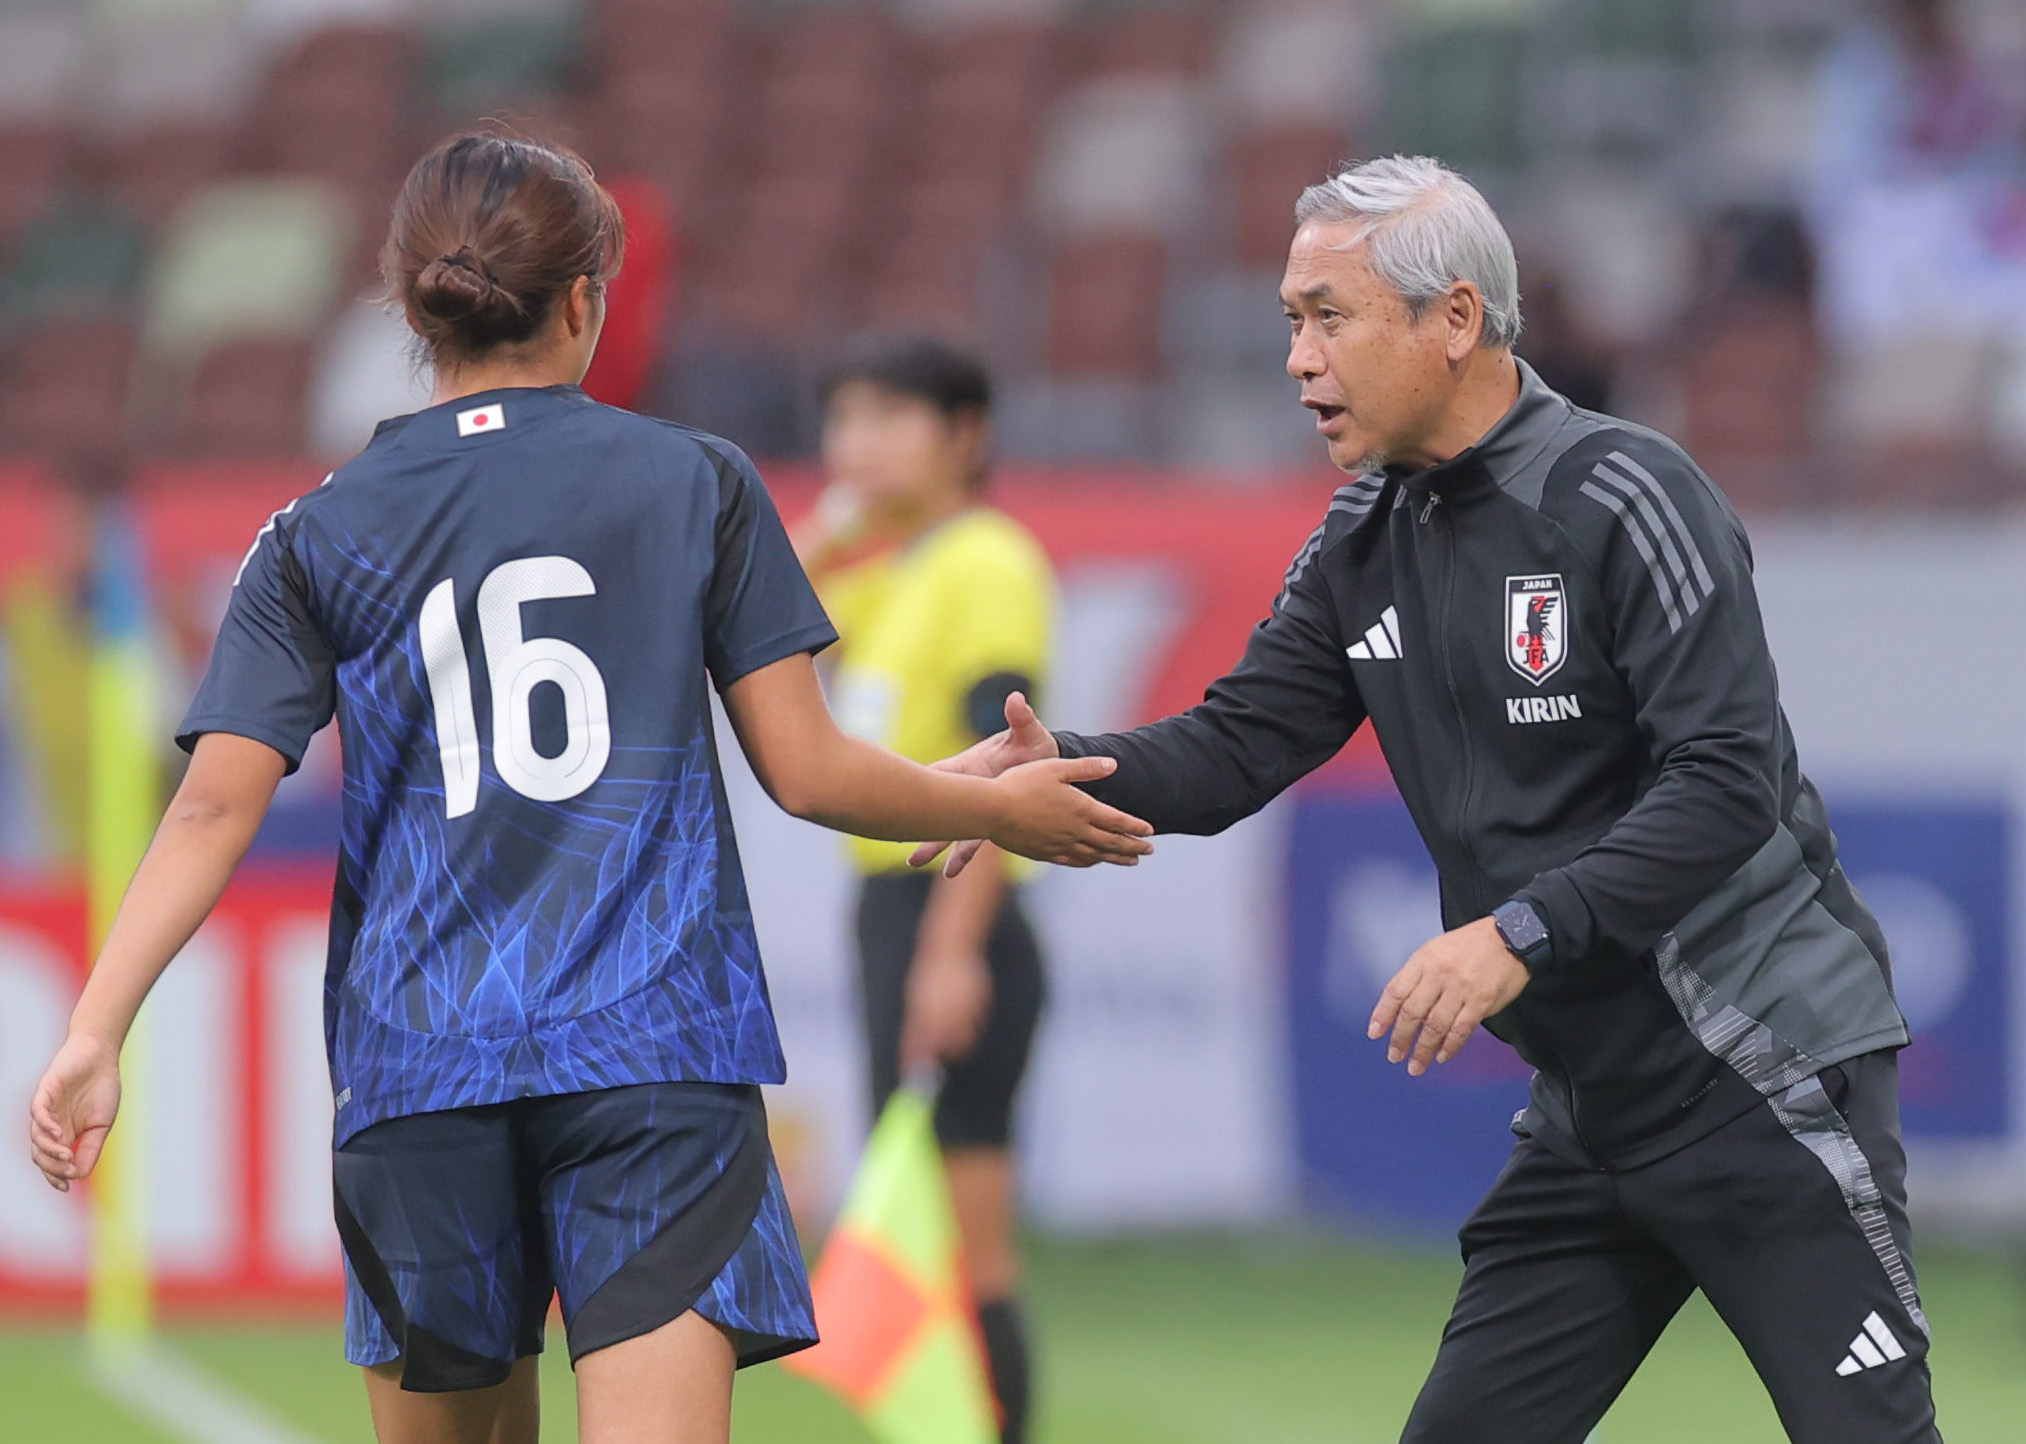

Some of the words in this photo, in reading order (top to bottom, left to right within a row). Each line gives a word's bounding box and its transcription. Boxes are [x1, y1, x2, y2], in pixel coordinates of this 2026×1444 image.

[1522, 580, 1552, 590] JAPAN
[1523, 649, 1549, 664] JFA
[419, 556, 610, 819] 16
[1506, 695, 1582, 723] KIRIN
